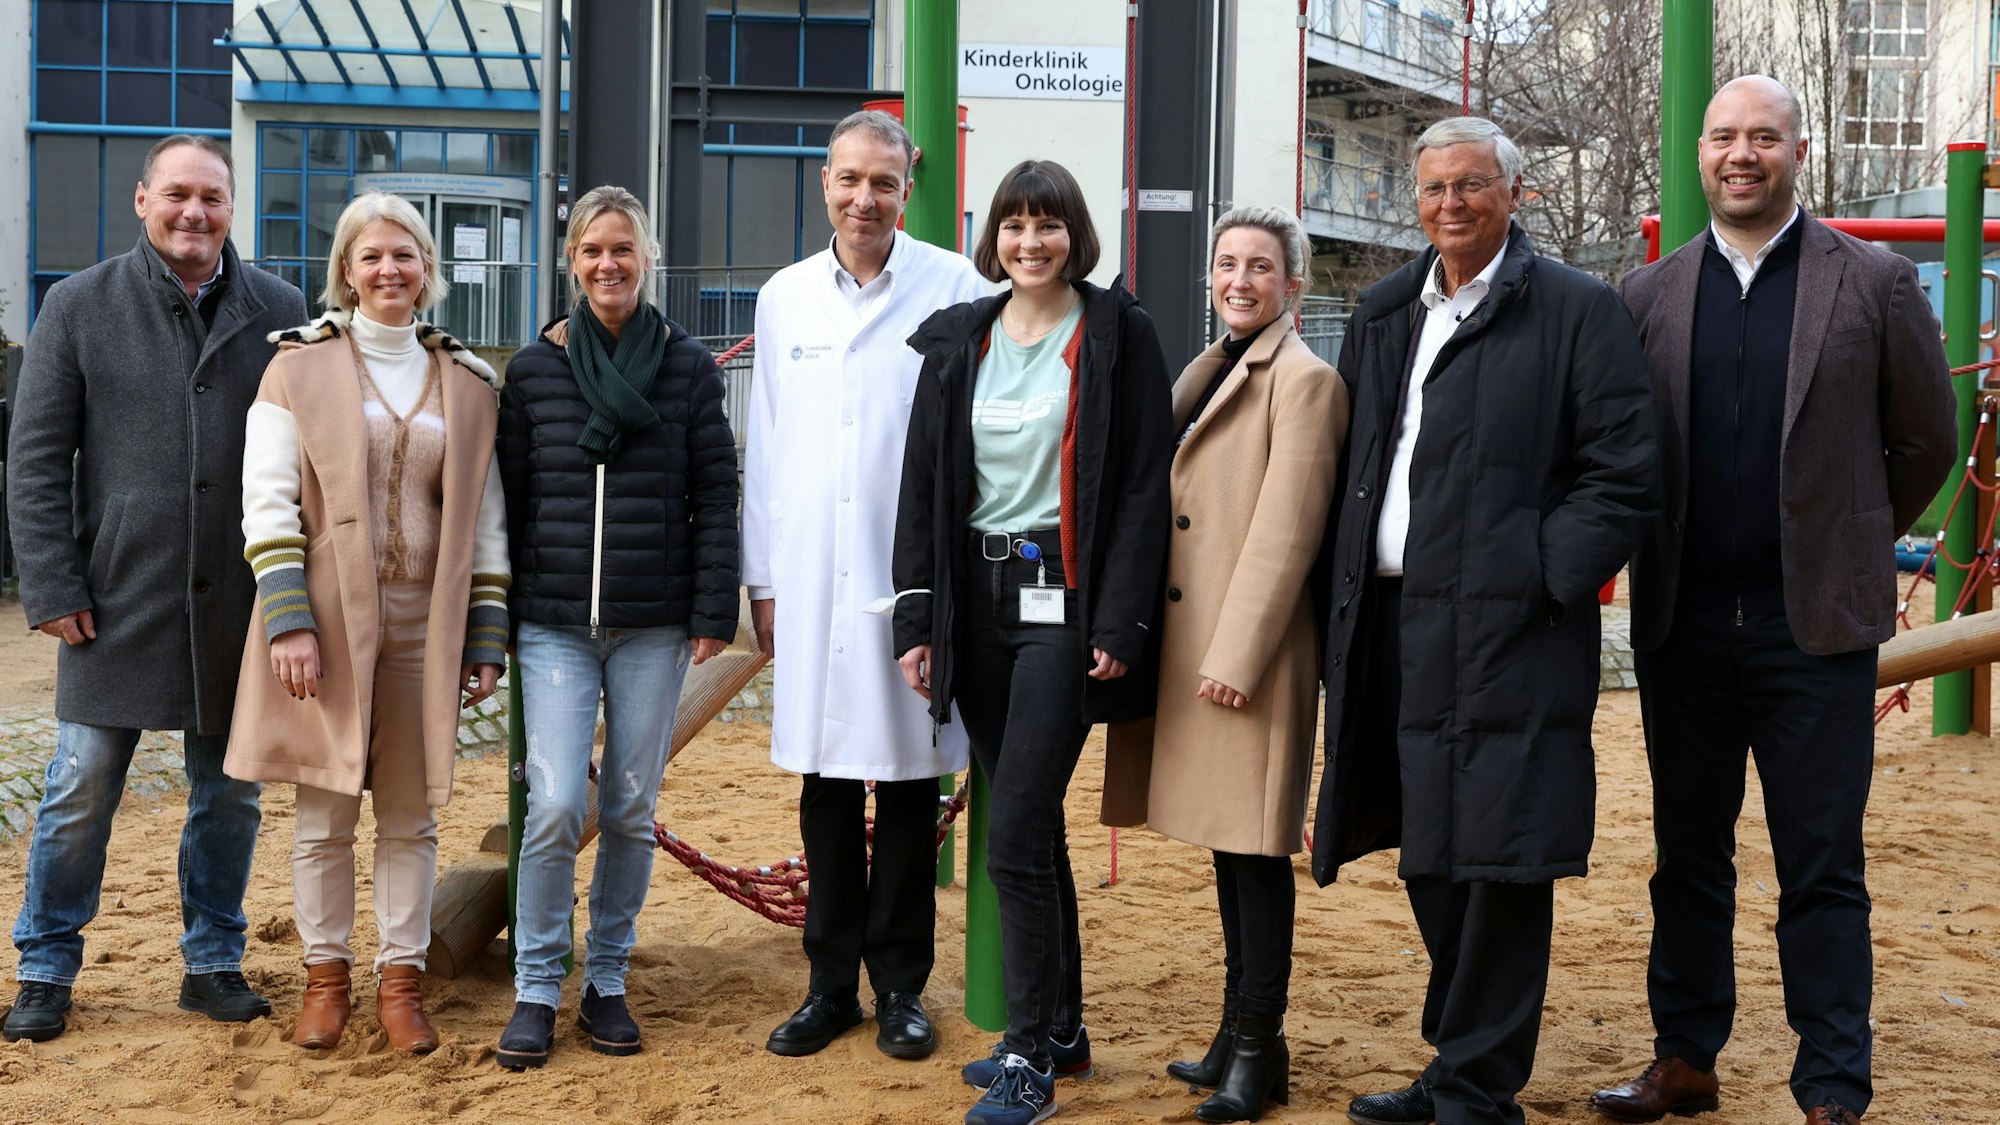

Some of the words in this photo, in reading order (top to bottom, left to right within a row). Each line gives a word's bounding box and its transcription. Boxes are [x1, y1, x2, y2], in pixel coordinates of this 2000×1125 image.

[964, 49, 1089, 70] Kinderklinik
[1015, 73, 1123, 96] Onkologie
[1146, 193, 1177, 202] Achtung!
